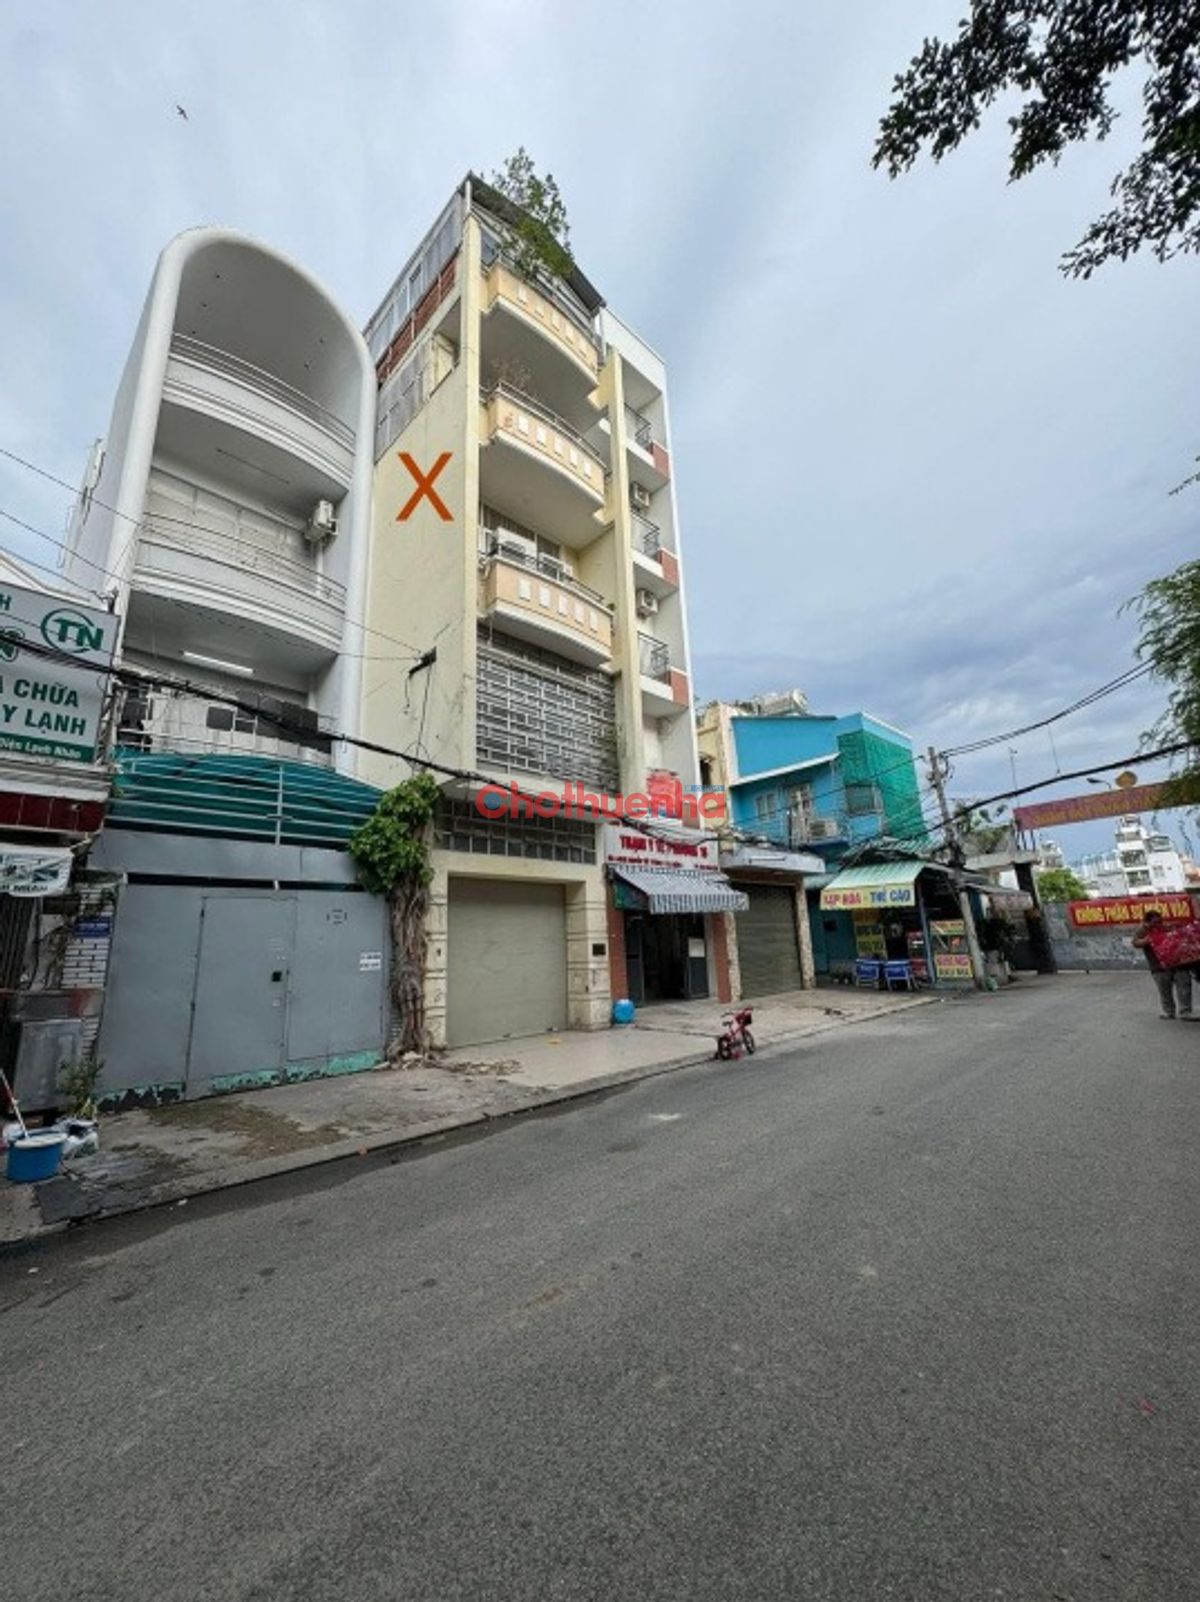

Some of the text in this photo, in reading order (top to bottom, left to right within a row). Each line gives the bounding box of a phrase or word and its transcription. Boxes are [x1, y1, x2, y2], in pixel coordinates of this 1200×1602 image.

[53, 618, 104, 651] TN
[14, 679, 78, 708] CHỮA
[25, 709, 87, 736] LẠNH
